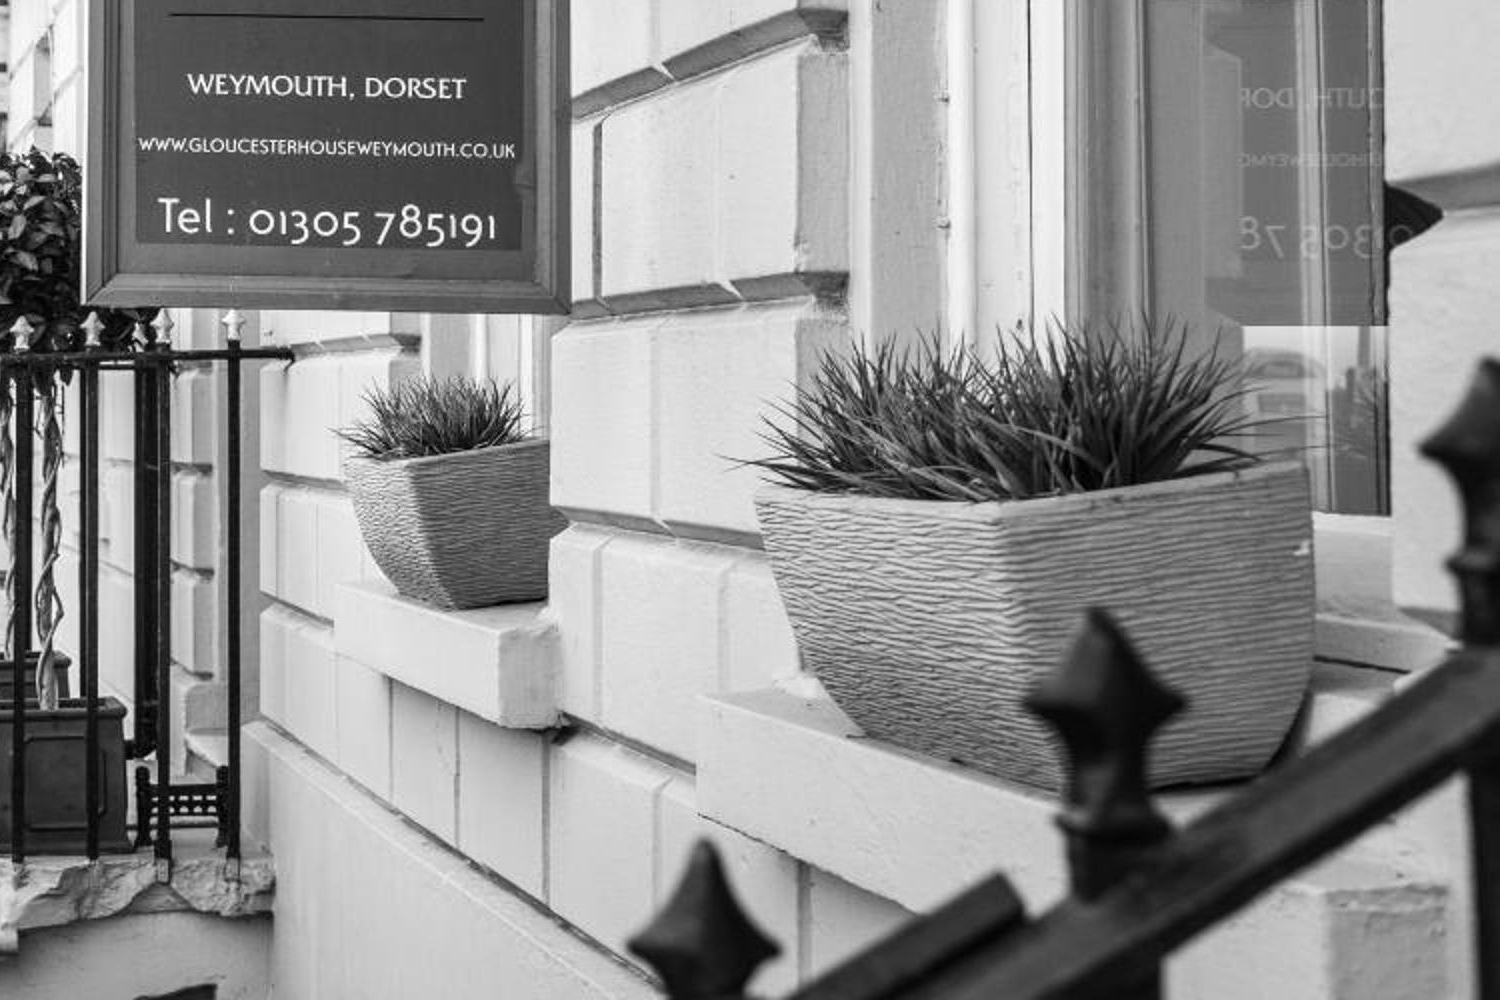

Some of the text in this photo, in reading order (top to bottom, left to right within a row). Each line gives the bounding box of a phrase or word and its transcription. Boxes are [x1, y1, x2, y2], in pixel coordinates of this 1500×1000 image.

[186, 73, 467, 101] WEYMOUTH, DORSET
[137, 136, 516, 160] WWW.GLOUCESTERHOUSEWEYMOUTH.CO.UK
[157, 197, 213, 235] Tel
[248, 206, 363, 249] 01305
[374, 202, 497, 249] 785191
